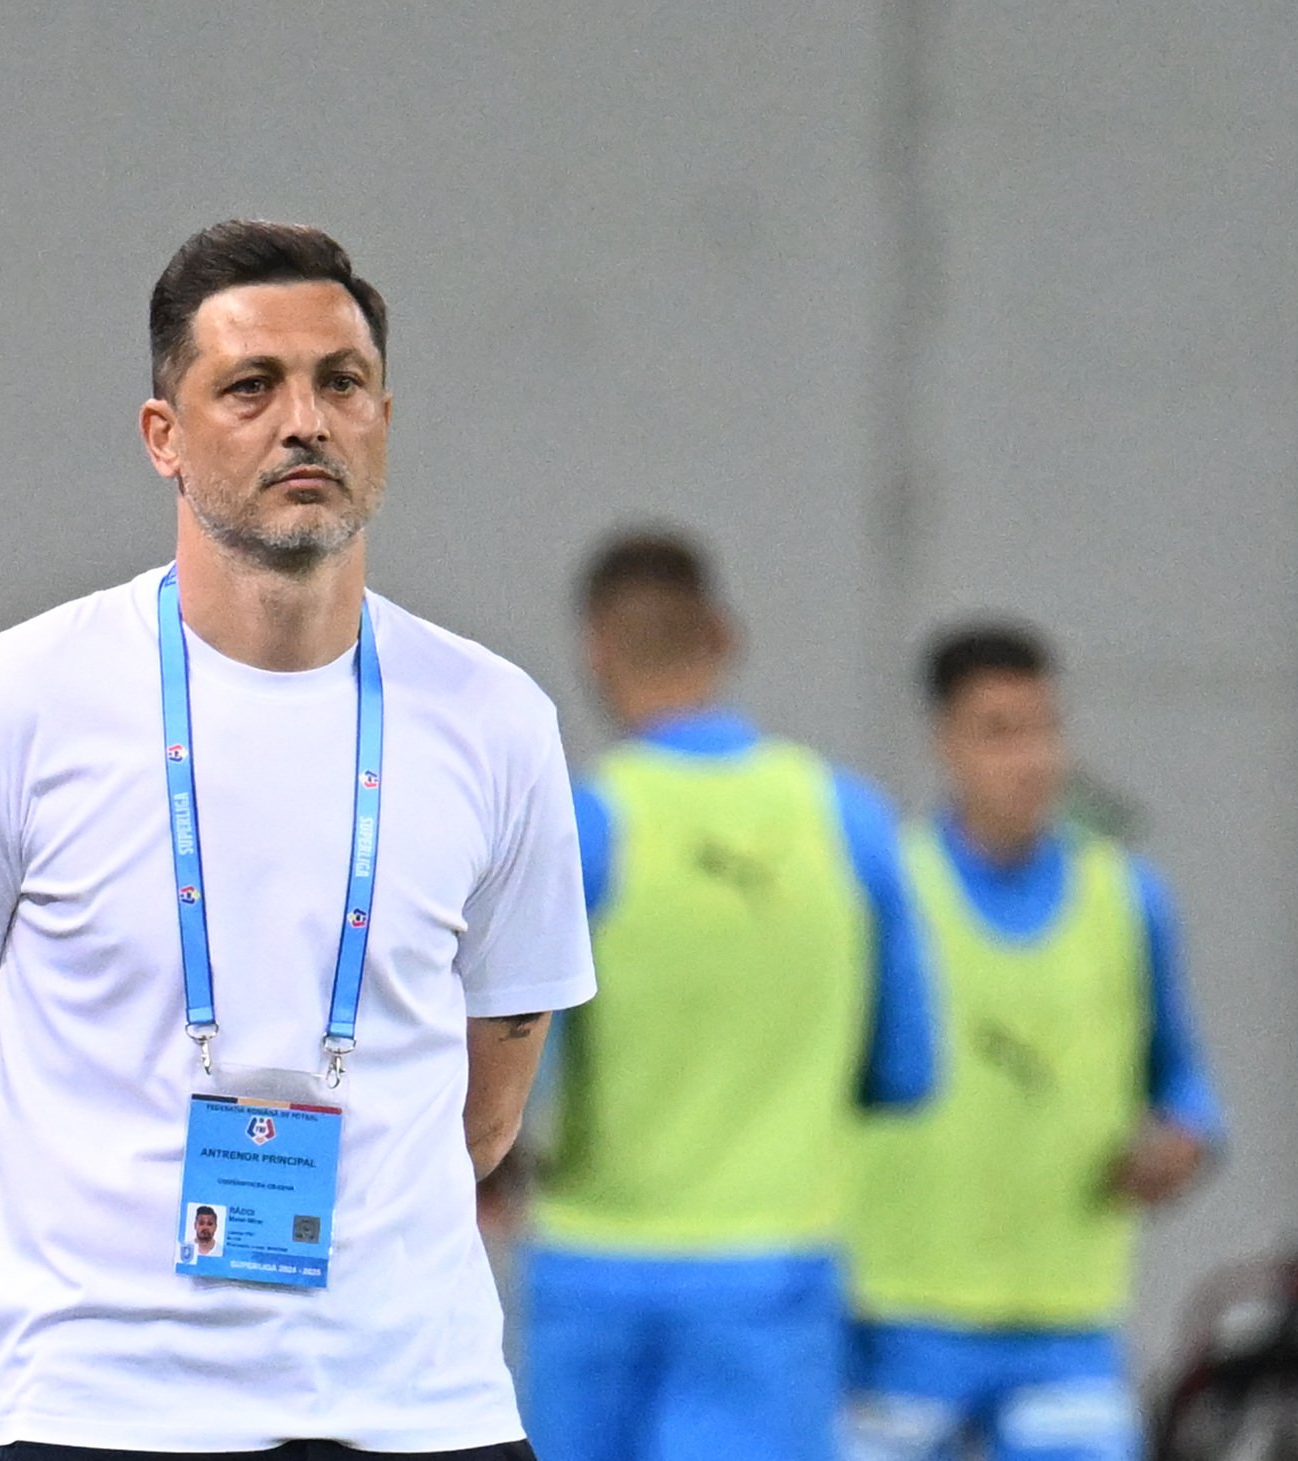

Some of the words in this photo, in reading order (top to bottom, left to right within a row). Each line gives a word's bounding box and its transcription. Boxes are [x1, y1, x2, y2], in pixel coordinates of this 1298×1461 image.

[173, 792, 194, 856] SUPERLIGA
[354, 815, 374, 878] SUPERLIGA
[200, 1148, 260, 1162] ANTRENOR
[262, 1153, 318, 1170] PRINCIPAL
